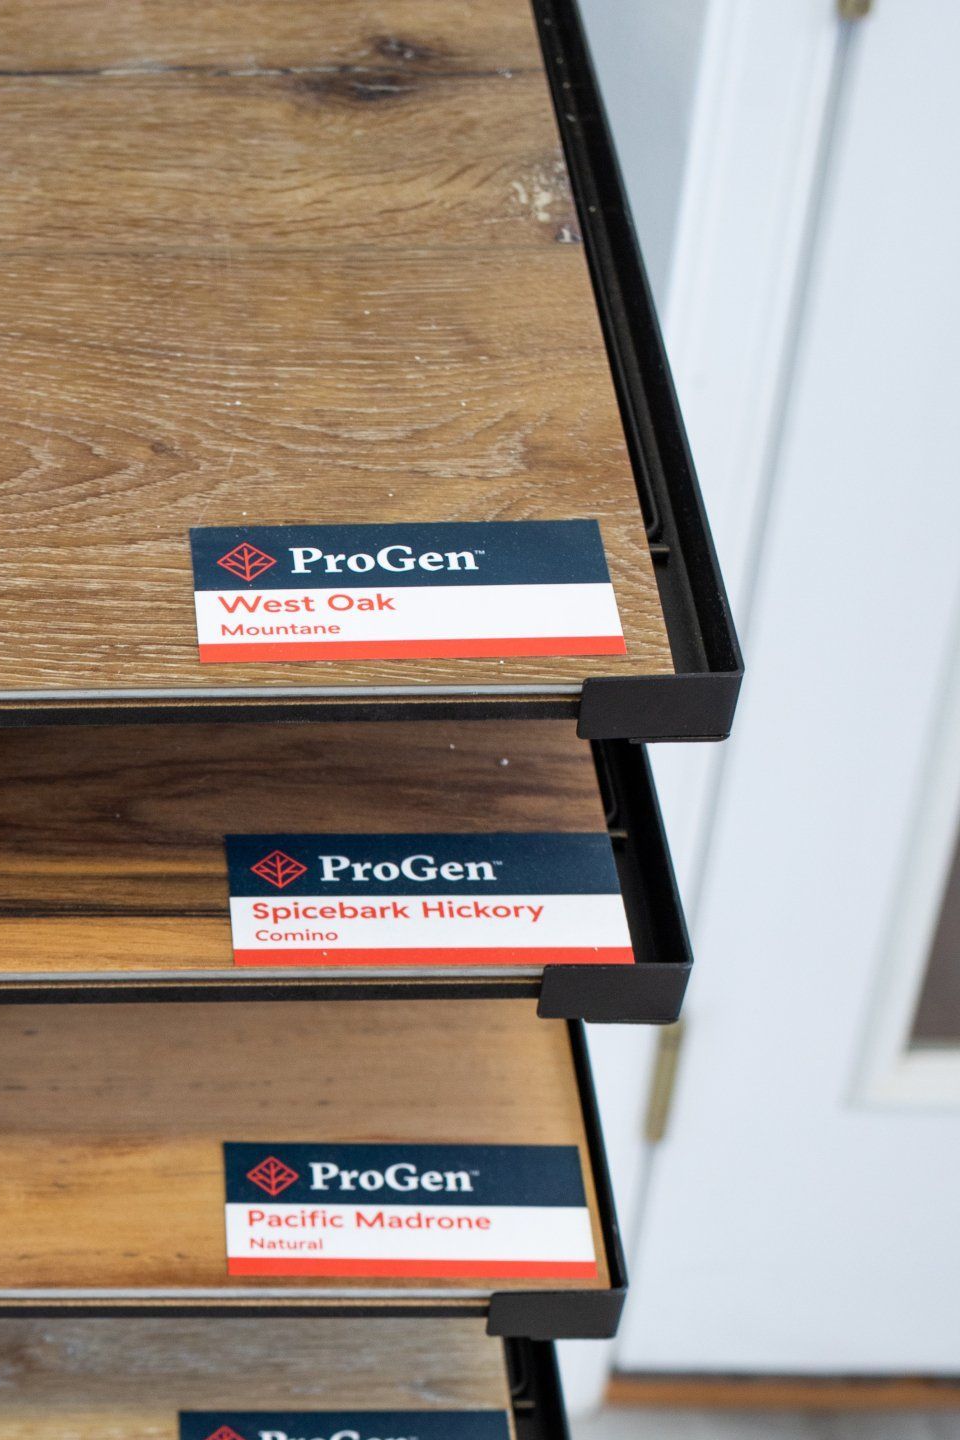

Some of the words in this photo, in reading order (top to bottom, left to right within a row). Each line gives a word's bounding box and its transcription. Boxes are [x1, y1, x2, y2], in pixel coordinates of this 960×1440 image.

[217, 594, 315, 614] West
[328, 593, 397, 612] Oak
[221, 622, 341, 637] Mountane
[252, 902, 410, 924] Spicebark
[422, 901, 545, 923] Hickory
[255, 929, 339, 942] Comino
[247, 1209, 344, 1229] Pacific
[356, 1211, 491, 1230] Madrone
[249, 1237, 324, 1250] Natural
